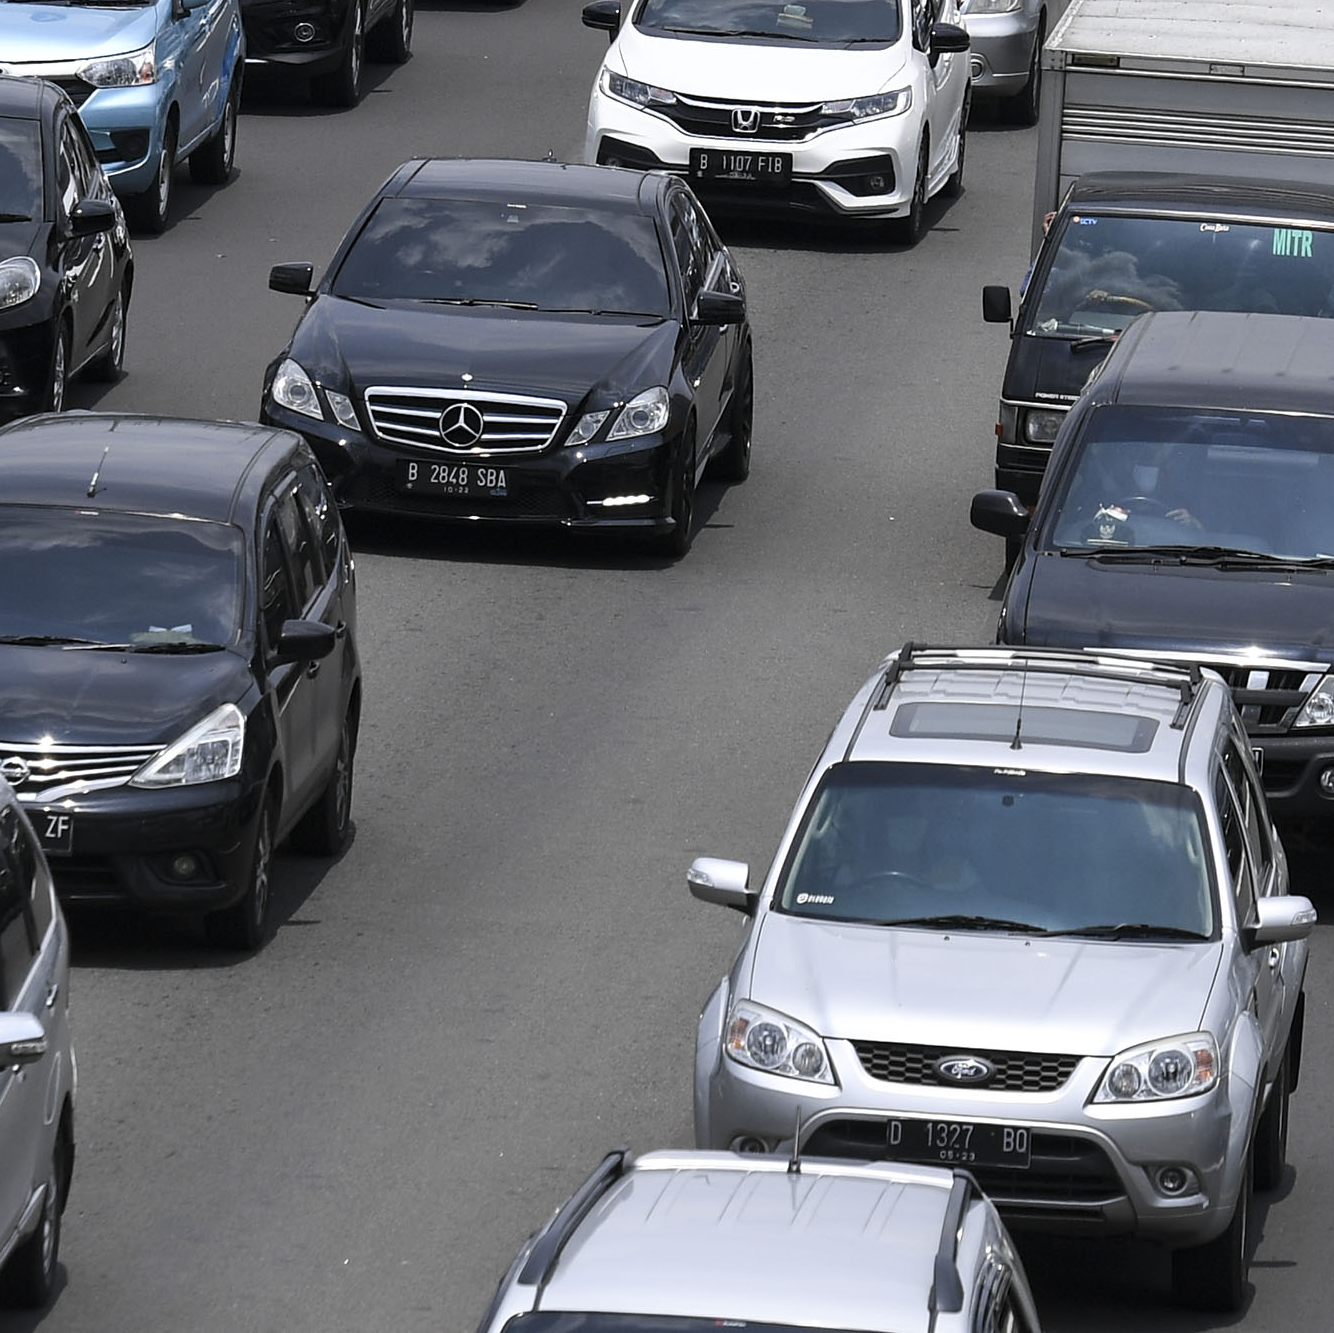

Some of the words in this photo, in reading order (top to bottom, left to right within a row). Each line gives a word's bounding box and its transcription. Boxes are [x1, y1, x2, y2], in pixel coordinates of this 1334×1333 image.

[700, 153, 708, 170] B
[722, 154, 753, 171] 1107
[758, 156, 783, 173] FIB
[1272, 228, 1314, 258] MITR
[408, 462, 418, 481] B
[430, 464, 468, 485] 2848
[477, 468, 507, 488] SBA
[45, 815, 69, 838] ZF
[890, 1120, 902, 1145] D
[926, 1122, 974, 1149] 1327
